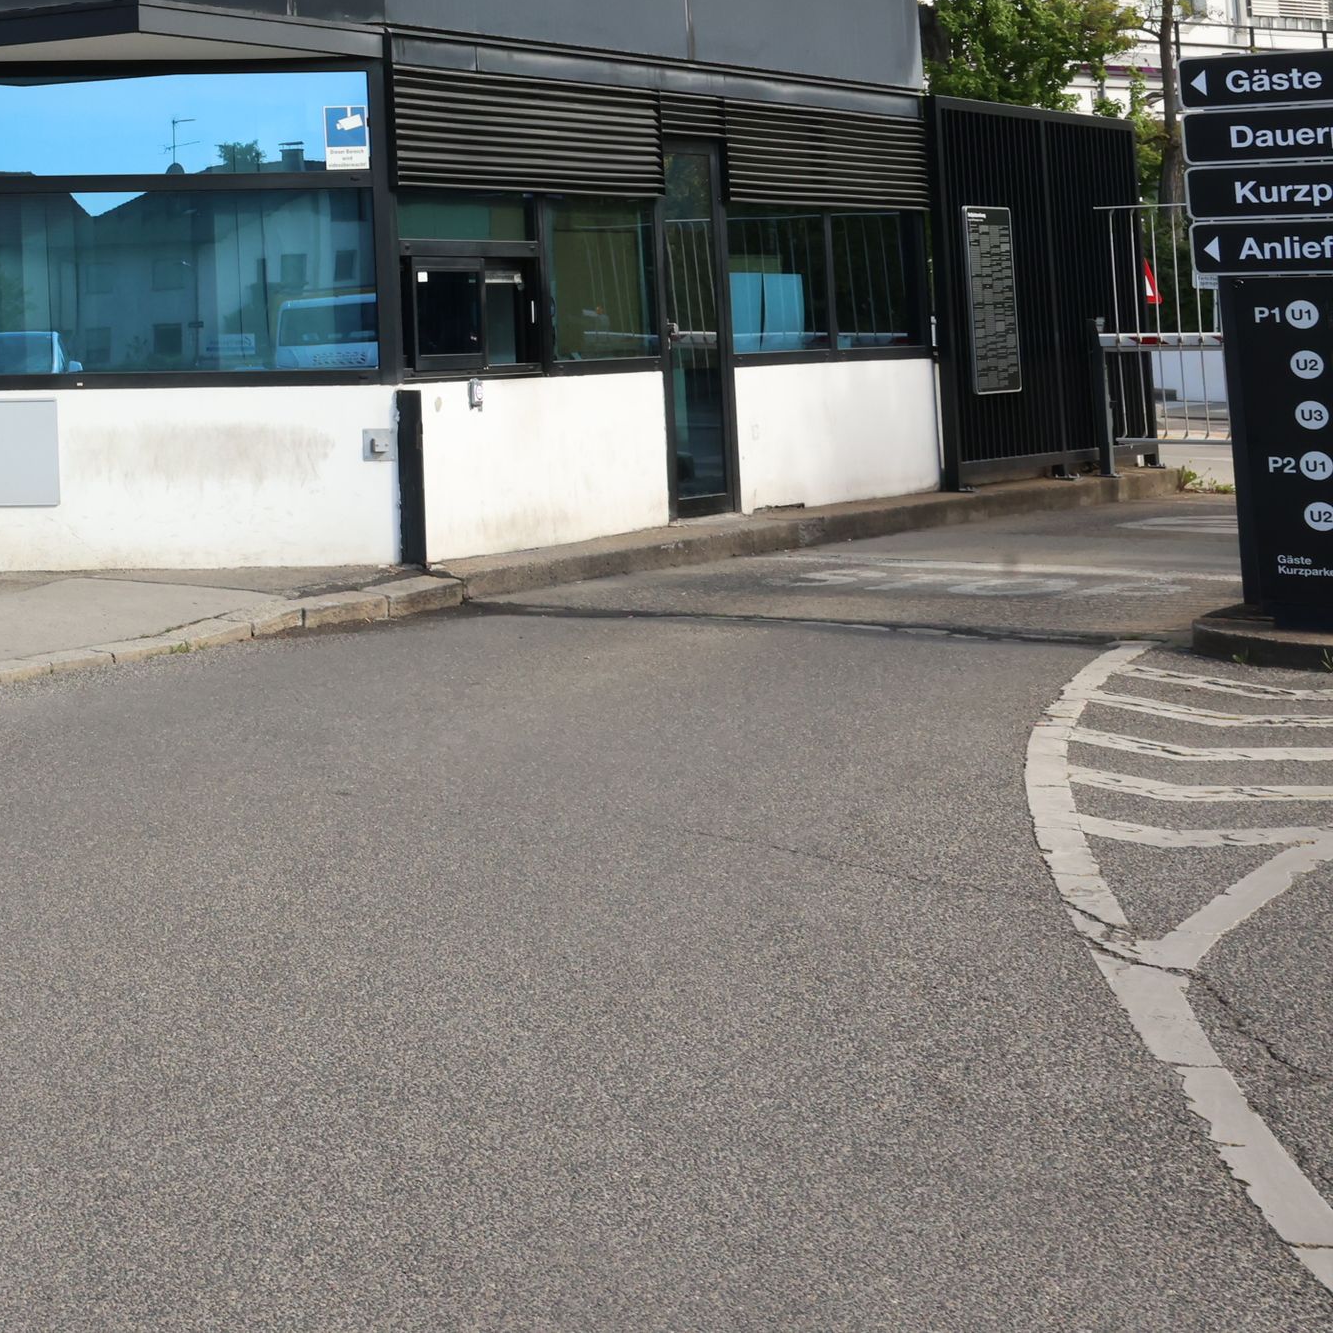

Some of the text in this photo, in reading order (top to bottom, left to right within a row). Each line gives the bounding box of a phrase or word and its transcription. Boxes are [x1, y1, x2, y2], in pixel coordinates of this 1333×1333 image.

[1225, 68, 1322, 93] Gäste
[1229, 125, 1333, 149] Dauer
[1254, 306, 1312, 323] P1 U1
[1296, 359, 1319, 371] U2
[1301, 409, 1324, 421] U3
[1268, 456, 1326, 473] P2 U1
[1310, 510, 1333, 523] U2
[1277, 554, 1313, 565] Gäste
